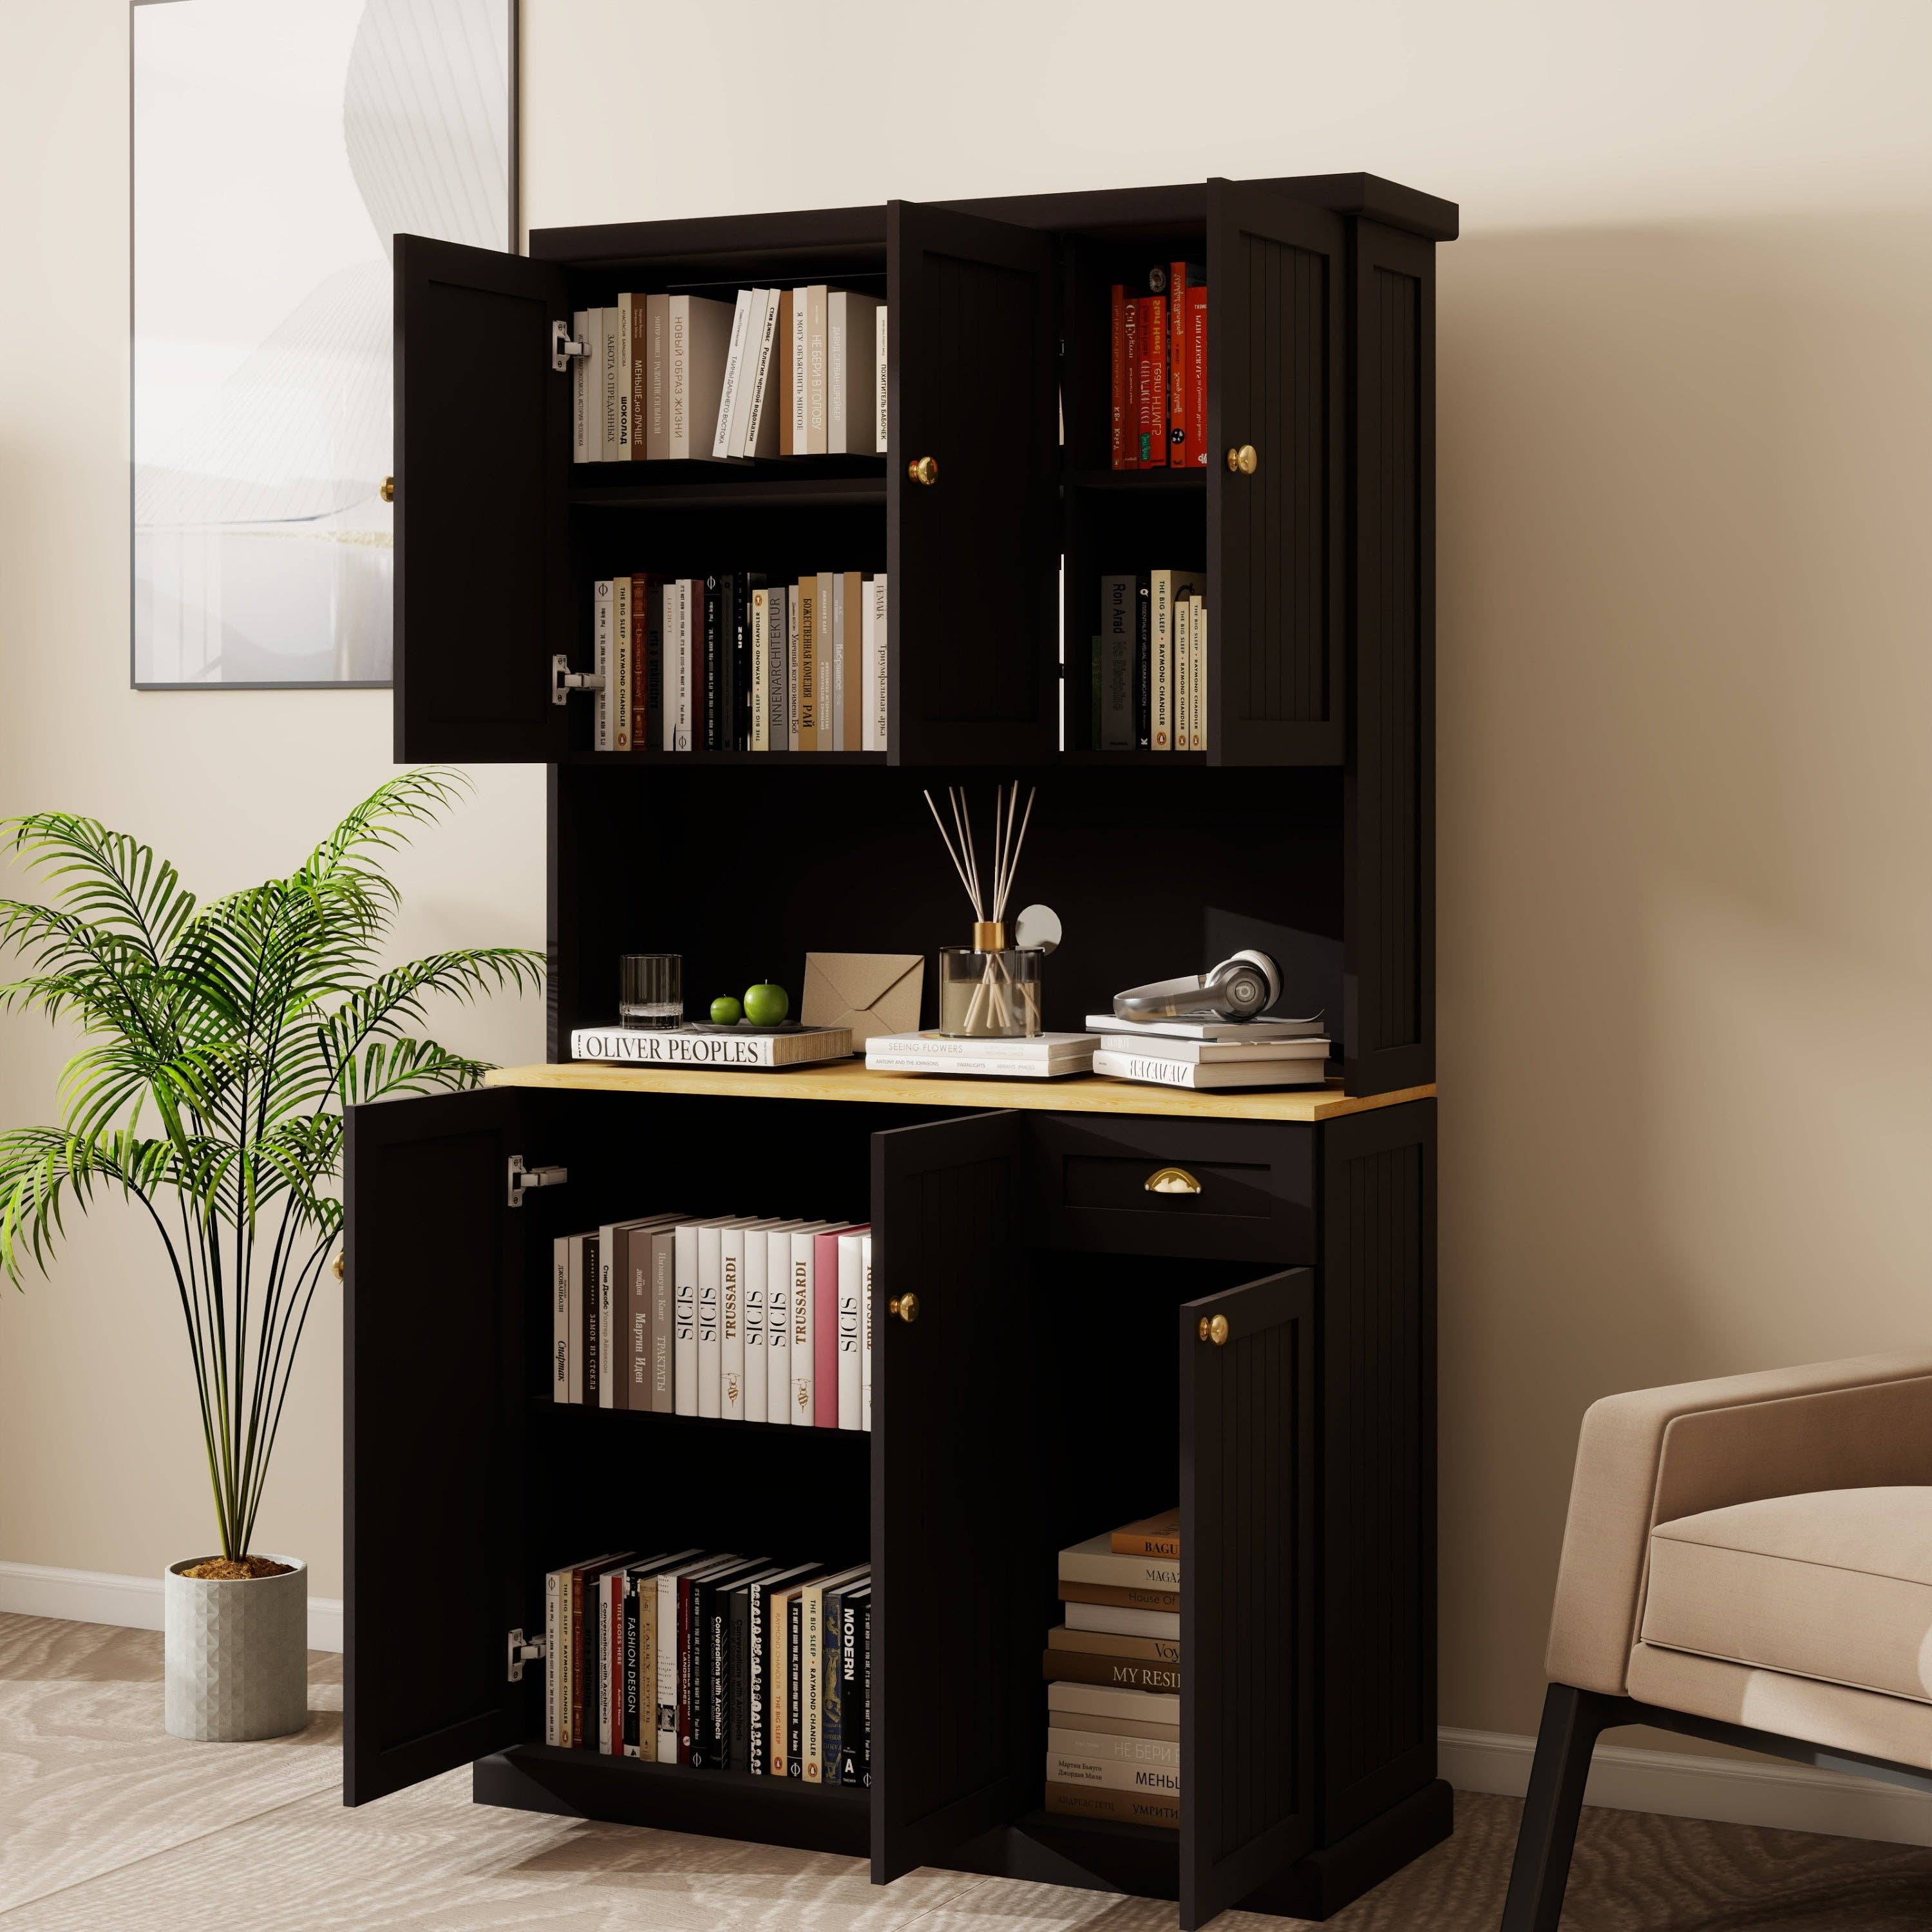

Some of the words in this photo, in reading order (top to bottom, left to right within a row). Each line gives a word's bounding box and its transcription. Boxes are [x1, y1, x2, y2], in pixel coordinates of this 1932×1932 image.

[675, 317, 684, 356] НОВЫЙ
[811, 335, 822, 349] НЕ
[759, 347, 769, 376] Религия
[811, 350, 822, 377] БЕРИ
[723, 379, 734, 413] ДАЛЬНЕГО
[755, 377, 764, 403] черной
[748, 404, 759, 442] водолазки
[811, 389, 822, 430] ГОЛОВУ
[634, 414, 642, 445] ЛУЧШЕ
[719, 413, 728, 444] ВОСТОКА
[1113, 583, 1126, 605] Ron
[803, 598, 811, 658] БОЖЕСТВЕННАЯ
[1113, 608, 1126, 634] Arad
[1142, 634, 1146, 642] OF
[770, 598, 783, 726] INNENARCHITEKTUR
[791, 683, 799, 693] по
[802, 661, 812, 697] КОМЕДИЯ
[878, 644, 887, 712] Триумфальная
[803, 705, 815, 728] РАЙ
[878, 715, 887, 736] арка
[586, 1036, 663, 1060] OLIVER
[668, 1039, 758, 1063] PEOPLES
[889, 1043, 919, 1051] SEEING
[923, 1045, 962, 1053] FLOWERS
[677, 1286, 693, 1340] SICIS
[726, 1256, 736, 1339] TRUSSARDI
[796, 1261, 806, 1345] TRUSSARDI
[700, 1288, 716, 1341] SICIS
[746, 1291, 762, 1345] SICIS
[770, 1292, 787, 1347] SICIS
[840, 1297, 858, 1352] SICIS
[634, 1312, 645, 1352] Мартин
[556, 1341, 567, 1382] Спартак
[590, 1346, 596, 1356] из
[657, 1336, 666, 1392] ТРАКТАТЫ
[634, 1358, 645, 1383] Иден
[1129, 1591, 1159, 1604] House
[1163, 1596, 1176, 1605] Of
[844, 1608, 854, 1680] MODERN
[1113, 1667, 1139, 1683] MY
[845, 1758, 854, 1774] A
[1114, 1741, 1132, 1757] НЕ
[1136, 1744, 1171, 1762] БЕРИ
[1058, 1770, 1084, 1779] Джордан
